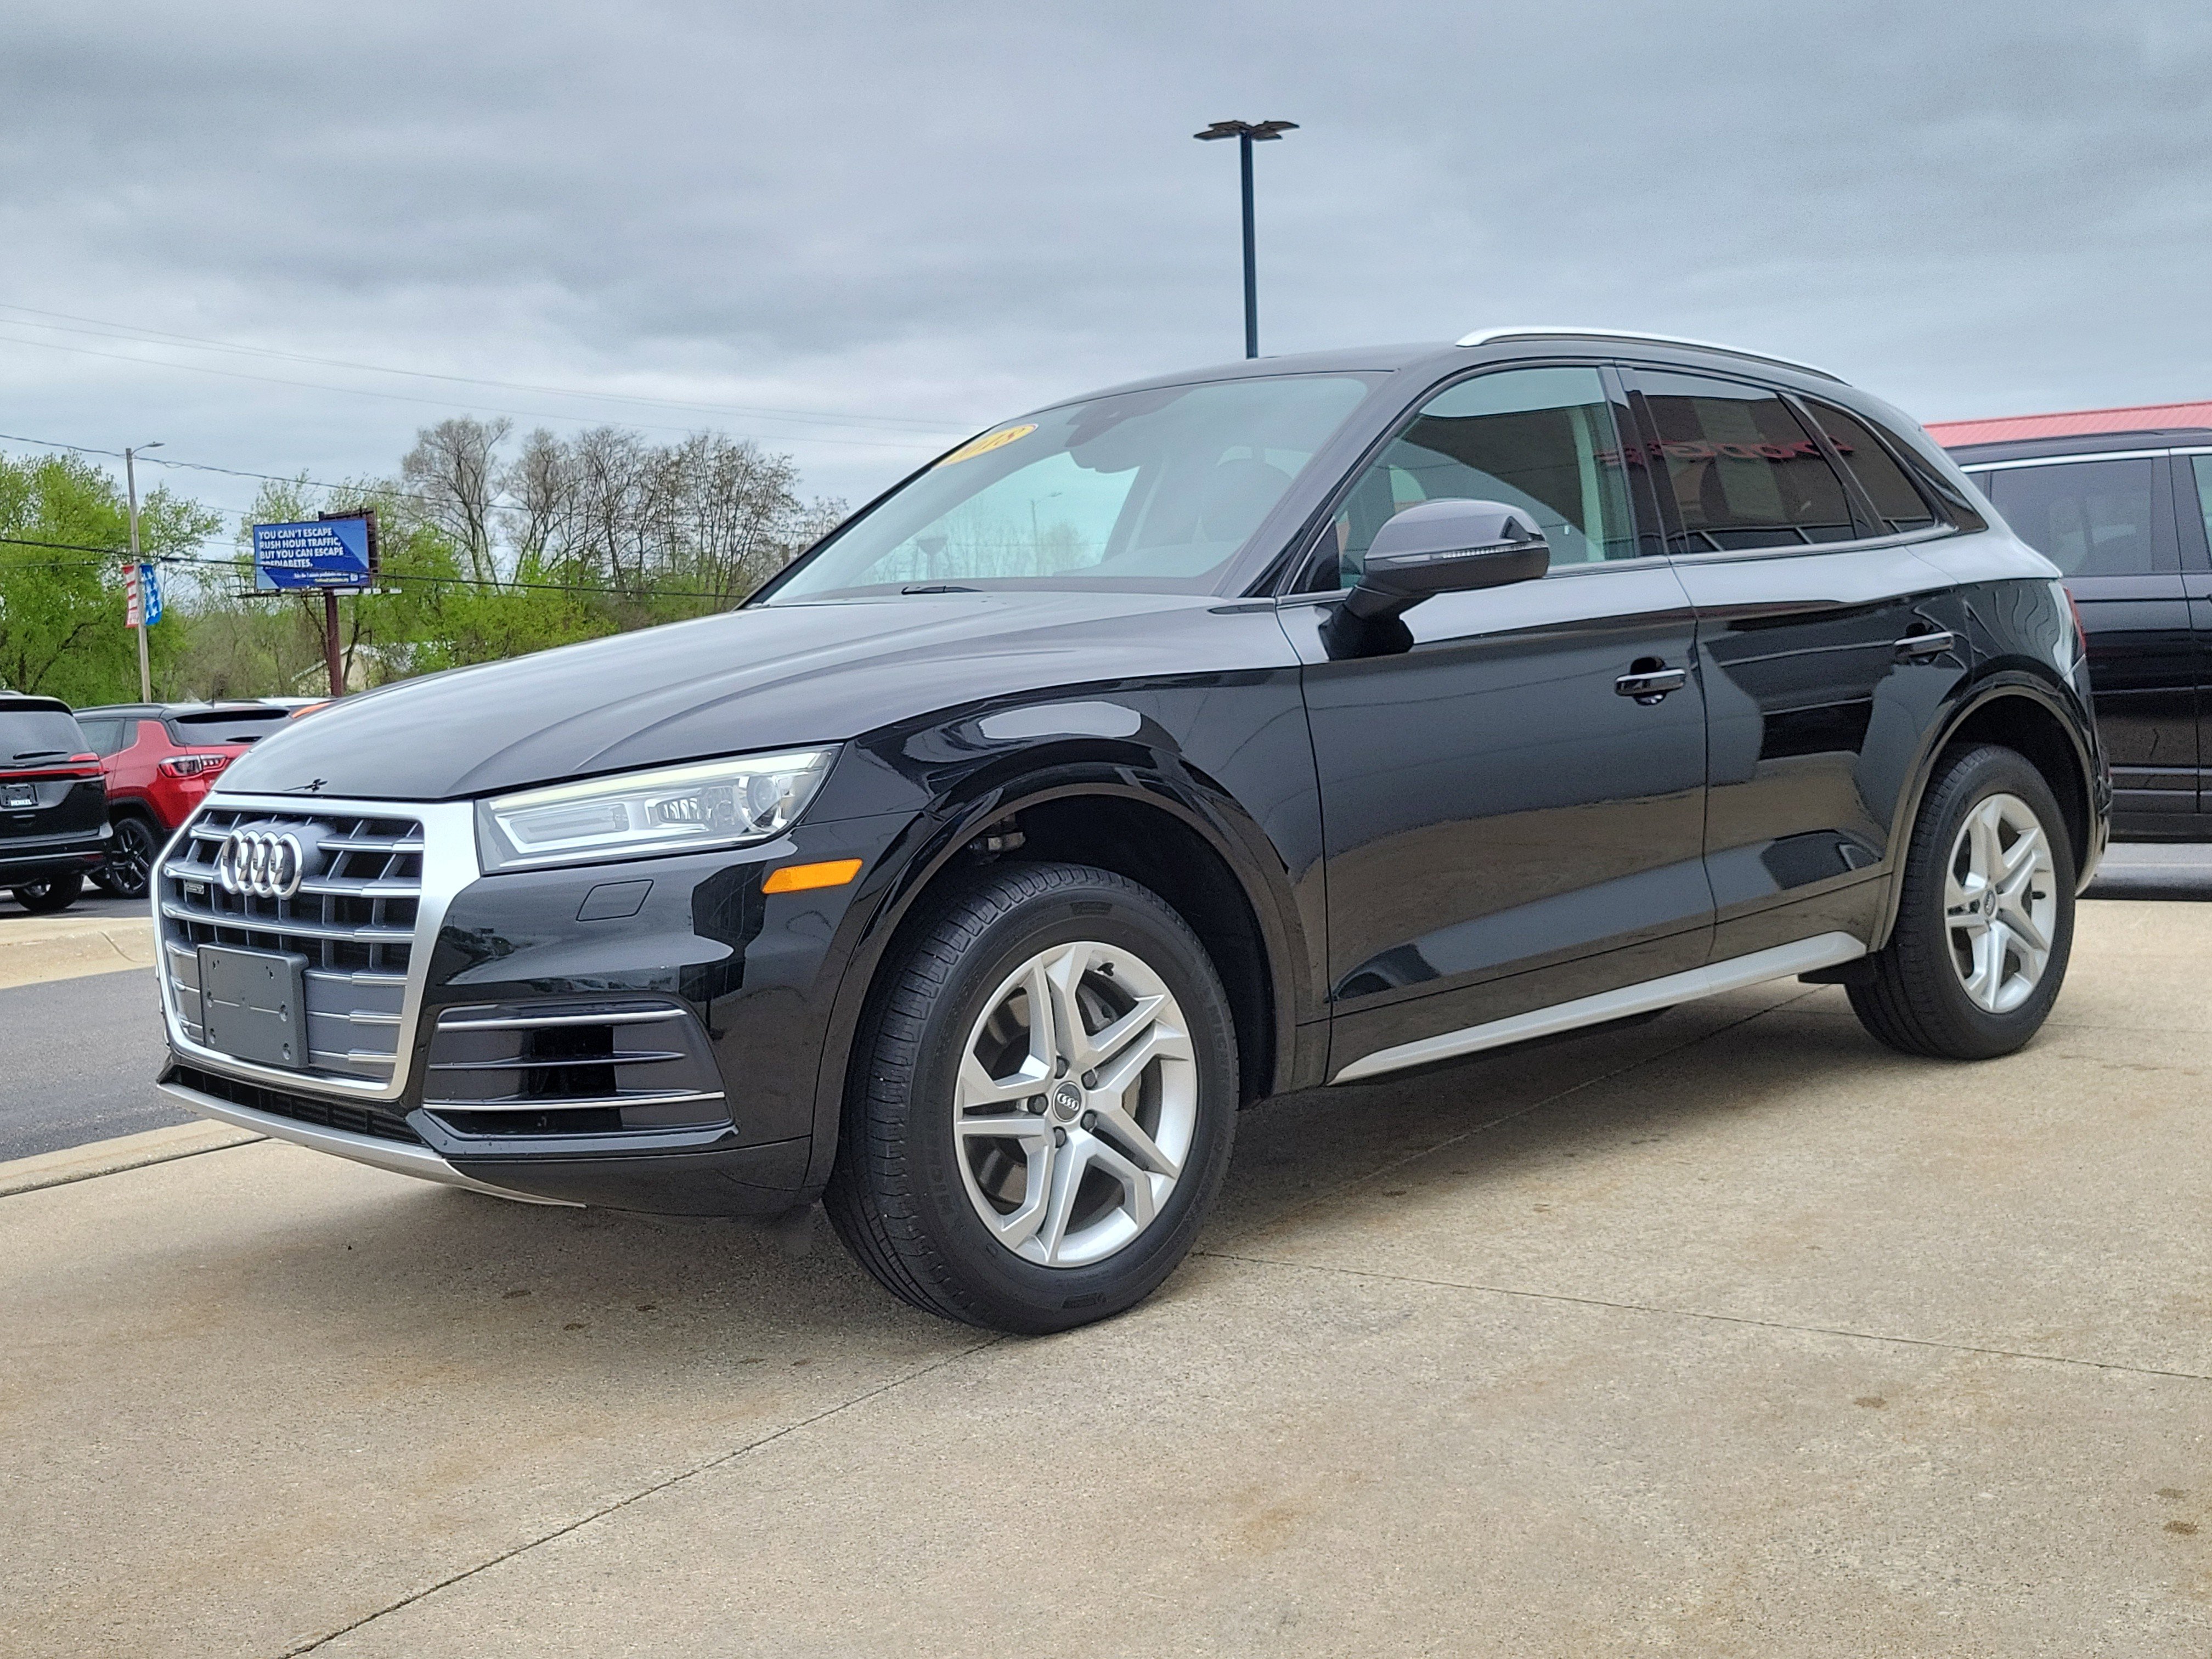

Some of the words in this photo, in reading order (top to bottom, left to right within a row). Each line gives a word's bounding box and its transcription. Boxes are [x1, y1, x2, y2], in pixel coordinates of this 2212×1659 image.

[259, 530, 276, 540] YOU
[278, 529, 302, 538] CAN'T
[303, 527, 332, 537] ESCAPE
[259, 540, 281, 549] RUSH
[282, 538, 307, 548] HOUR
[308, 537, 341, 547] TRAFFIC,
[259, 550, 275, 559] BUT
[276, 549, 294, 558] YOU
[295, 548, 313, 557] CAN
[314, 546, 344, 556] ESCAPE
